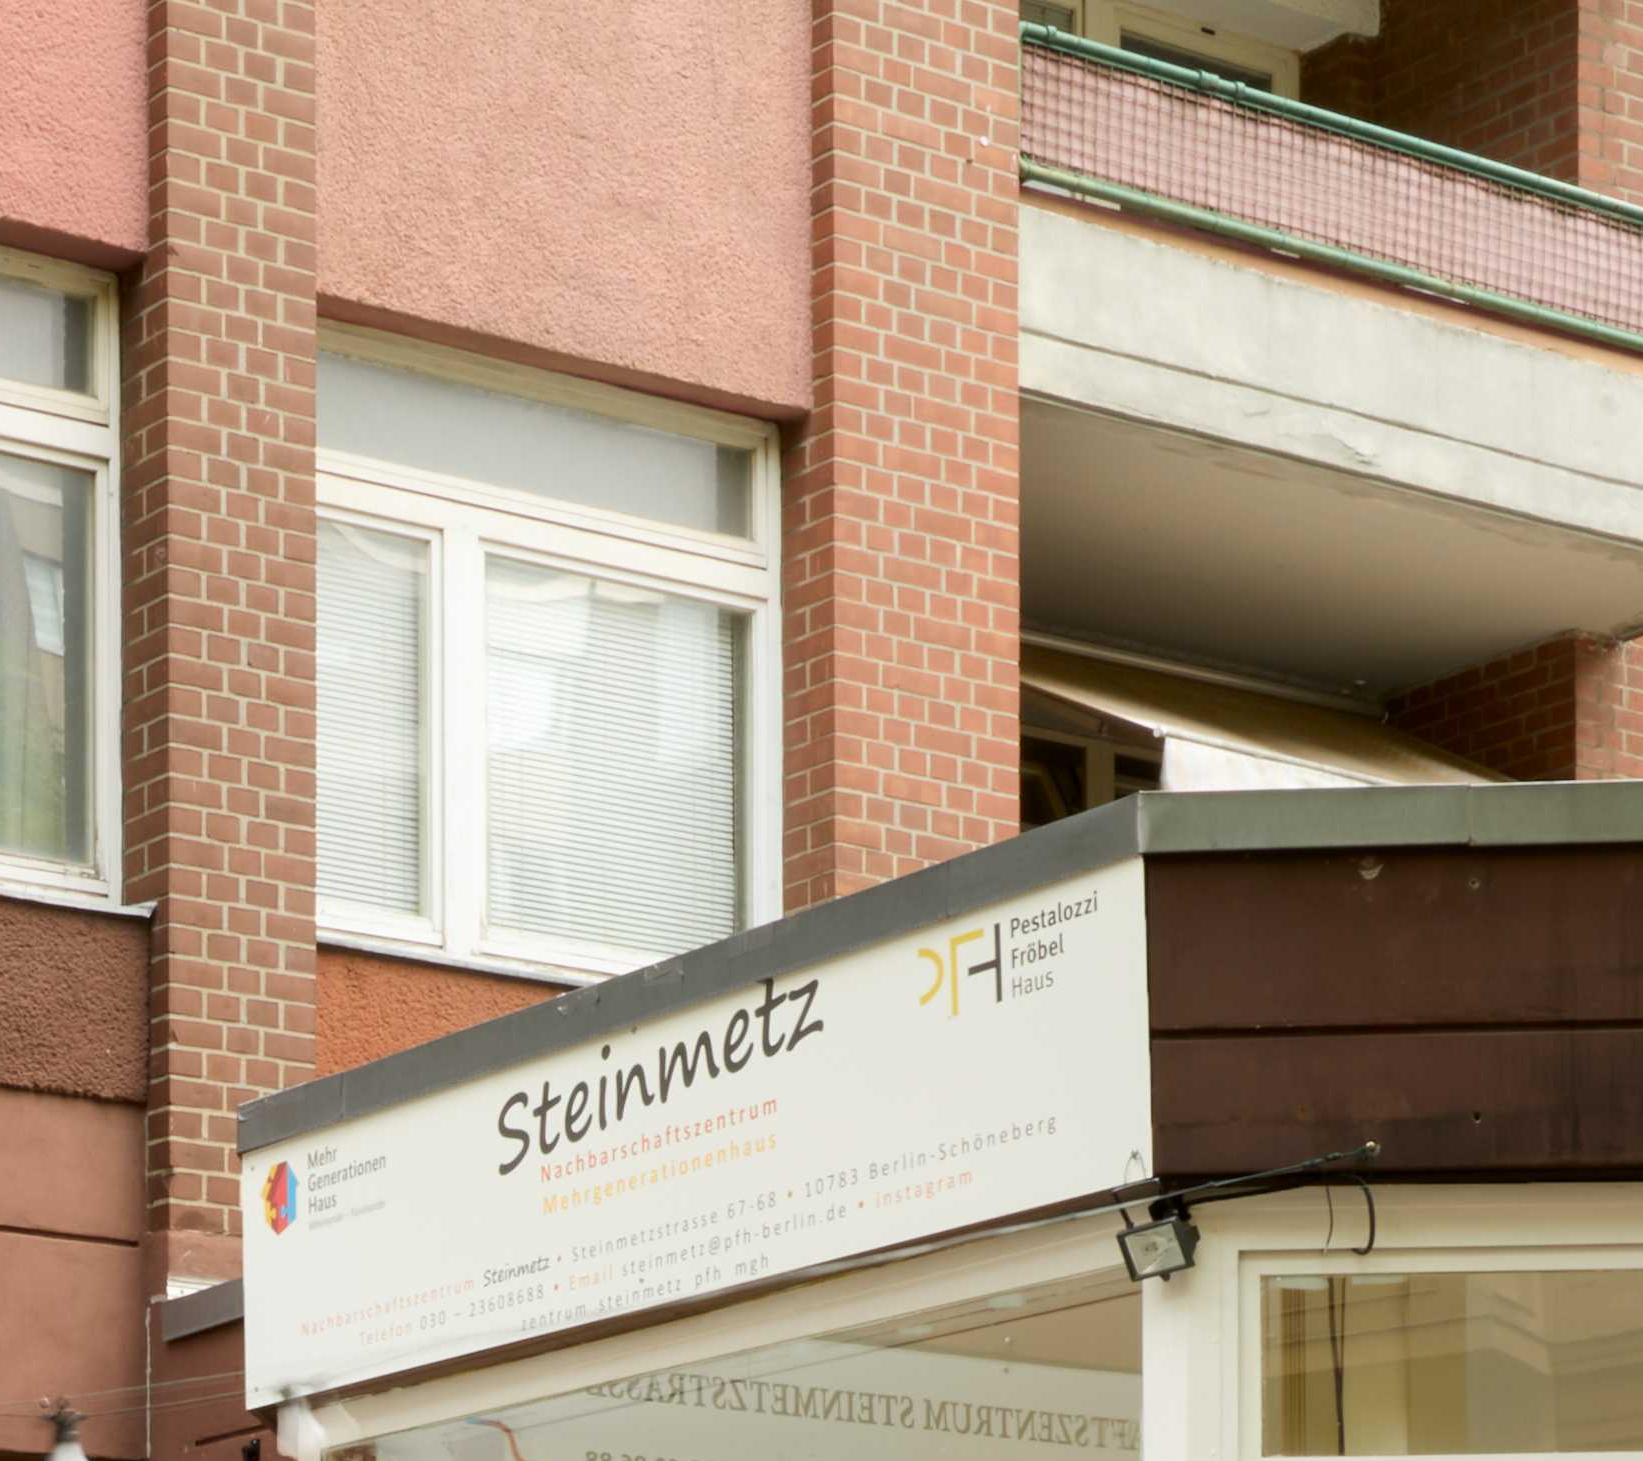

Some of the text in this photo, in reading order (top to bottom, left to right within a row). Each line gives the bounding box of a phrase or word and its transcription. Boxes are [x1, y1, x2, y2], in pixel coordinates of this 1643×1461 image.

[1010, 891, 1099, 938] Pestalozzi
[1011, 933, 1065, 969] Fröbel
[1011, 971, 1055, 998] Haus
[498, 977, 825, 1176] Steinmetz
[306, 1145, 338, 1170] Mehr
[540, 1098, 778, 1183] Nachbarschaftszentrum
[307, 1154, 387, 1192] Generationen
[307, 1192, 338, 1215] Haus
[541, 1133, 778, 1216] Mehrgenerationenhaus
[300, 1114, 1058, 1338] Nachbarschaftszentrum Steinmetz Steinmetzstrasse 67-68 10783 Berlin-Schöneberg
[359, 1319, 412, 1348] Telefon
[419, 1310, 447, 1331] 030
[468, 1284, 545, 1318] 23608688
[568, 1270, 614, 1292] Email
[621, 1202, 849, 1277] steinmetz@pfh-berlin.de
[875, 1169, 974, 1208] instagram
[521, 1253, 770, 1332] zentrum steinmetz pfh mgh
